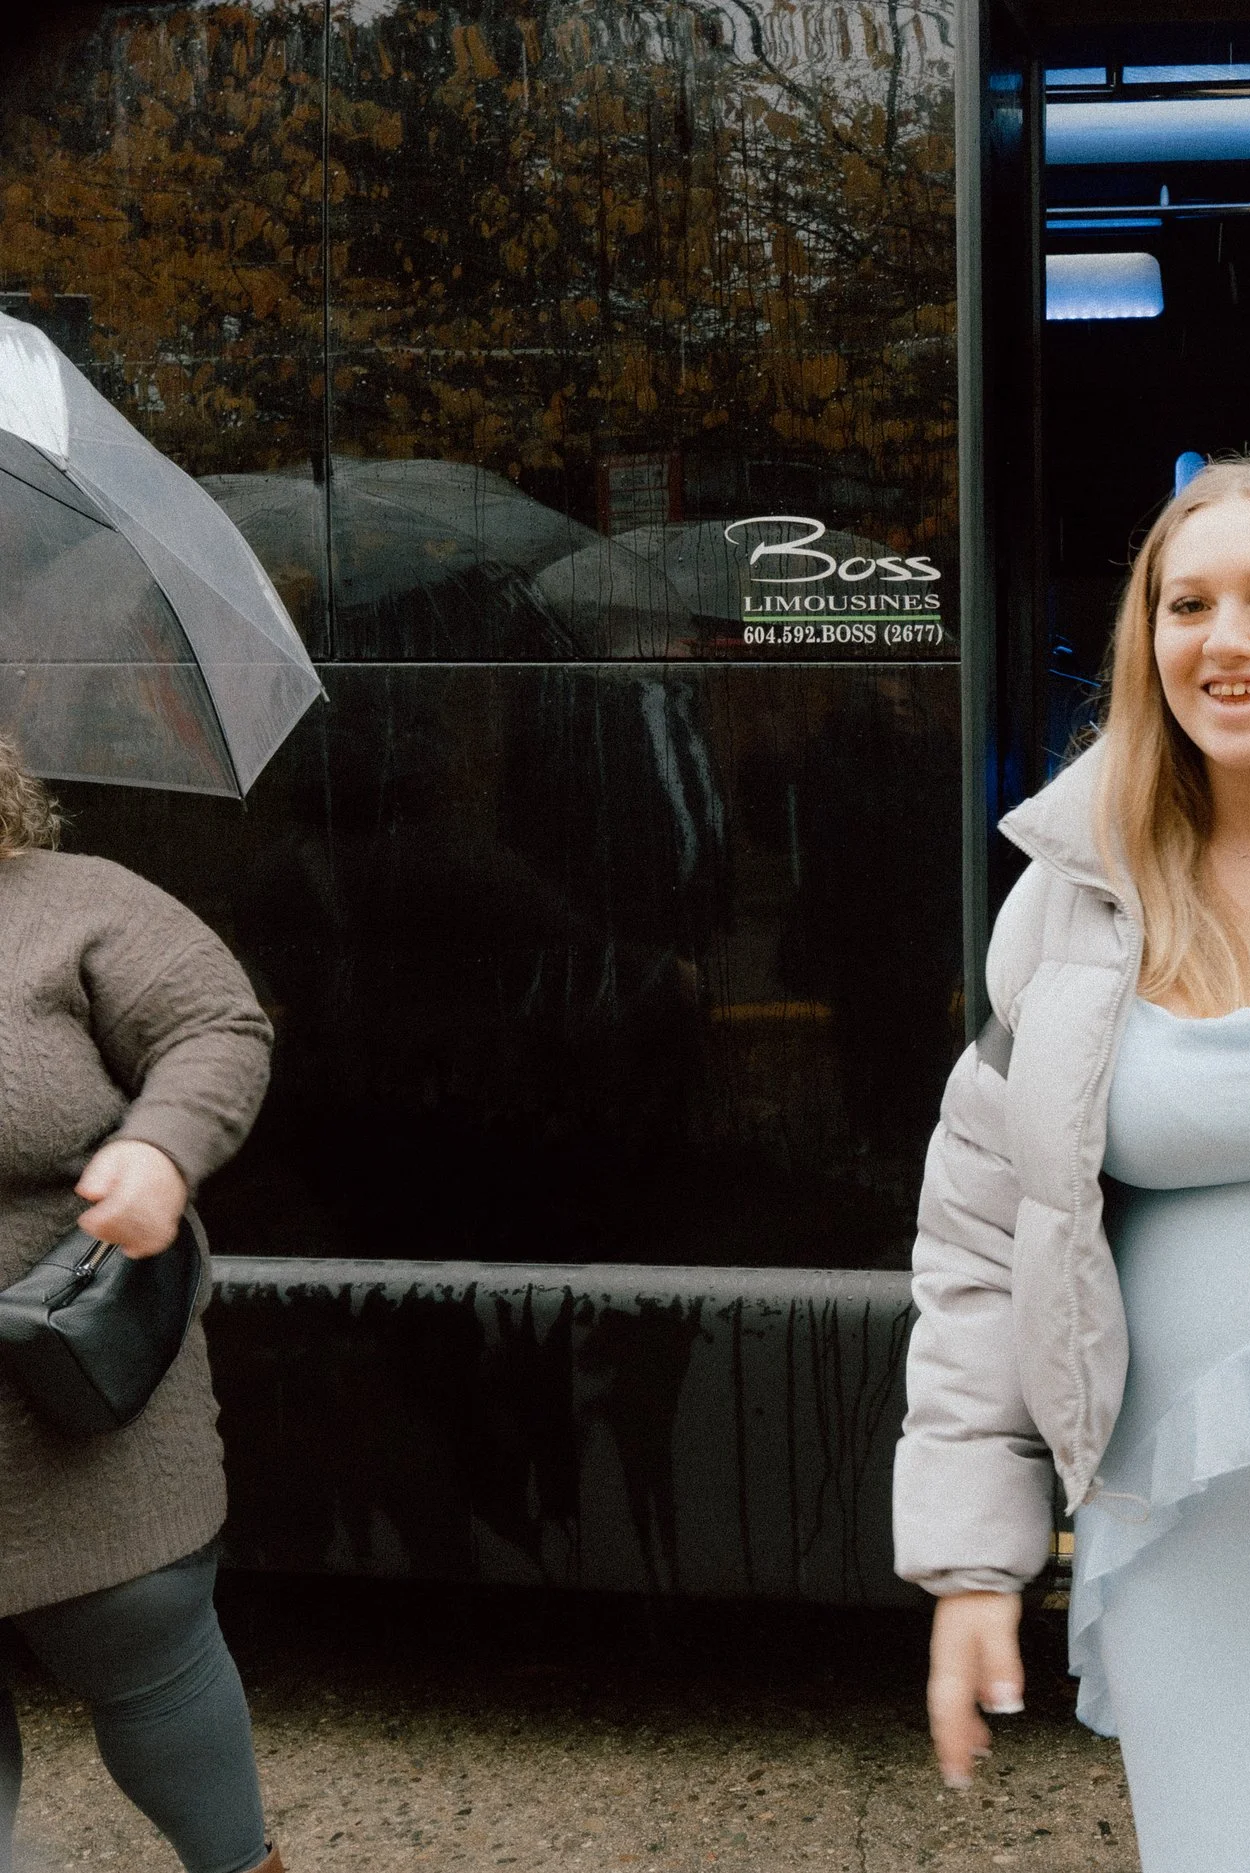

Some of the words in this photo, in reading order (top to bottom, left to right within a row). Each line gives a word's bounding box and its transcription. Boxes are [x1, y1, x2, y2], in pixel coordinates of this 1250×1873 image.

[744, 594, 941, 612] LIMOUSINES
[743, 624, 876, 644] 604.592.BOSS
[884, 624, 943, 646] (2677)
